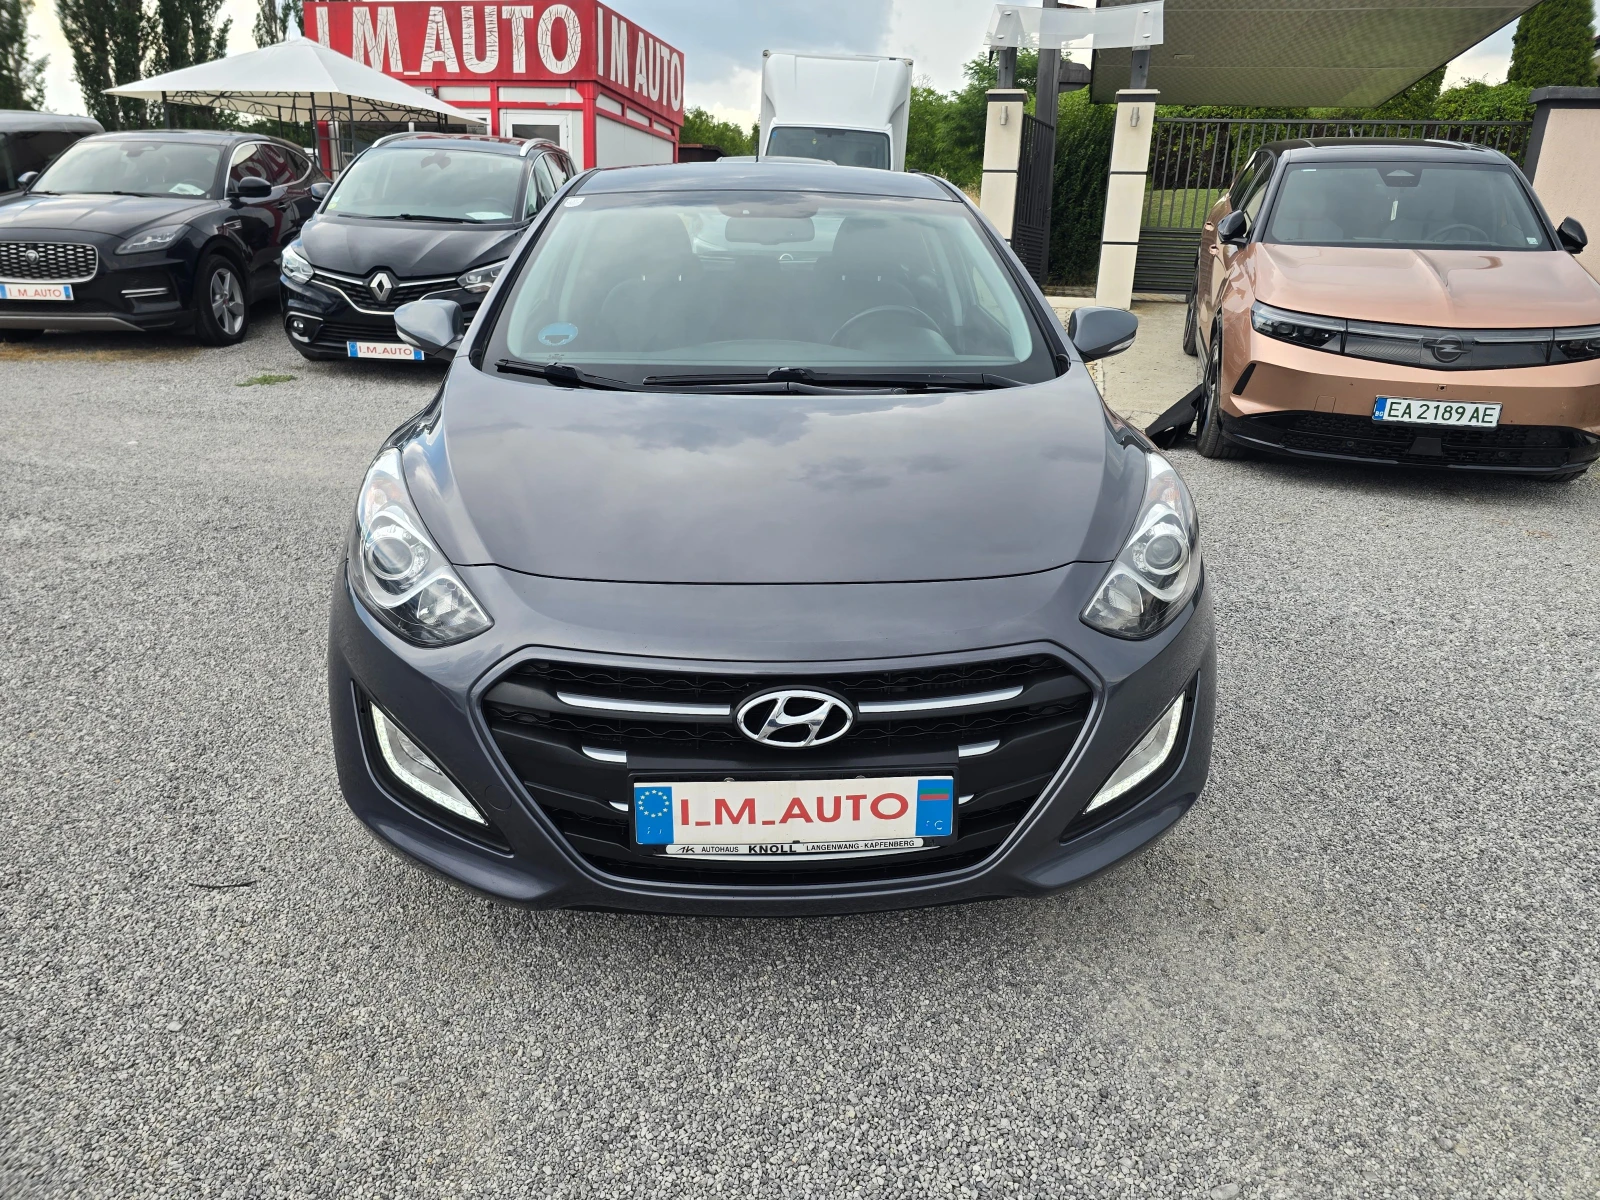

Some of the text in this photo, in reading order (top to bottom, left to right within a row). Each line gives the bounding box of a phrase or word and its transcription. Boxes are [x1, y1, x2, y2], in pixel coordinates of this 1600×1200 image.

[634, 31, 682, 112] AUTO
[1416, 403, 1466, 422] 2189
[748, 845, 797, 854] KNOLL
